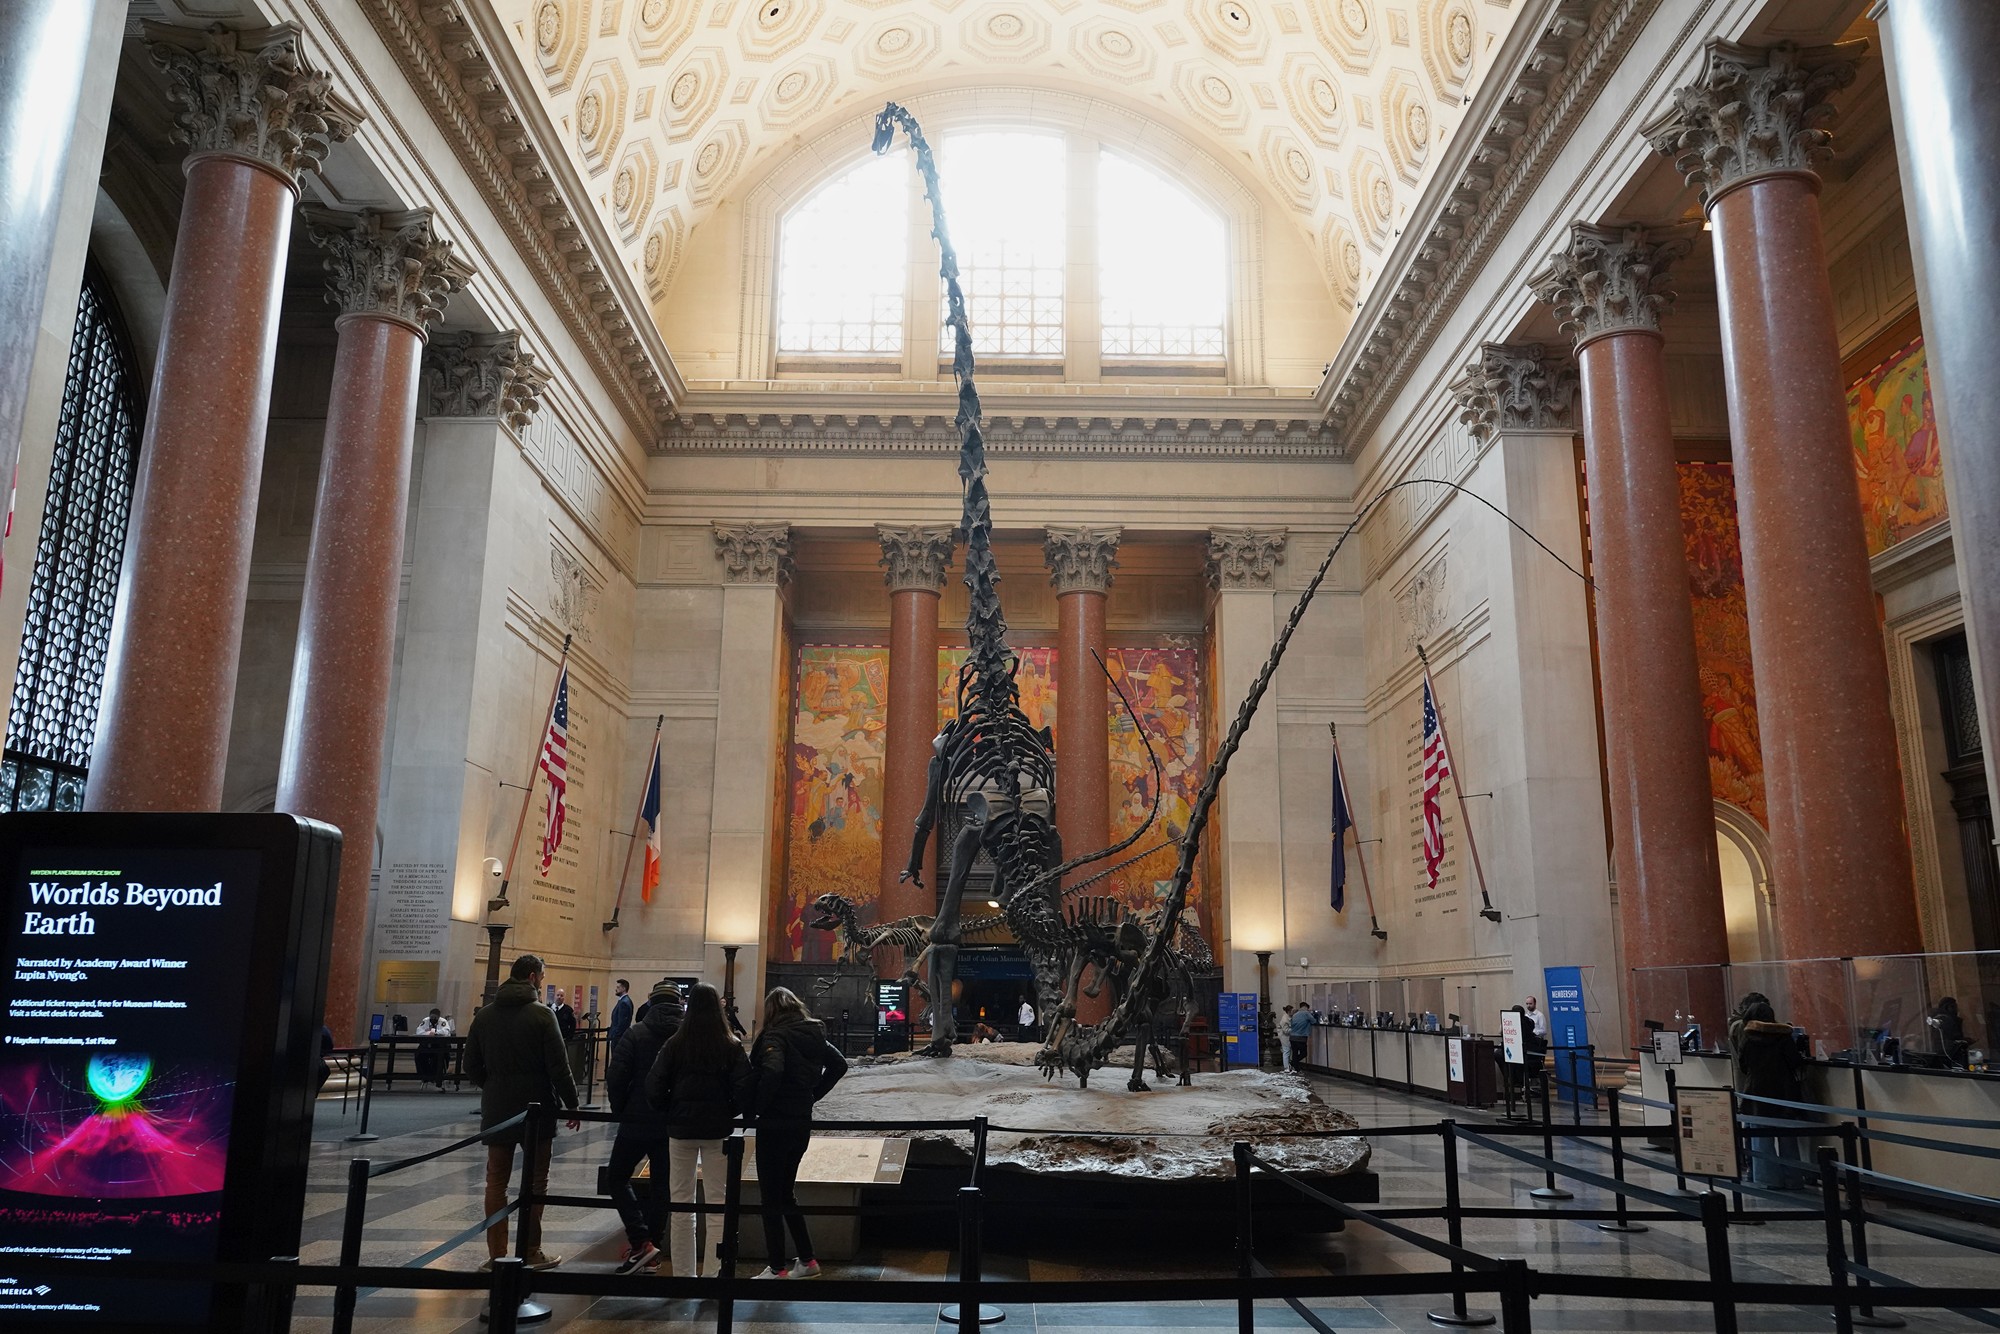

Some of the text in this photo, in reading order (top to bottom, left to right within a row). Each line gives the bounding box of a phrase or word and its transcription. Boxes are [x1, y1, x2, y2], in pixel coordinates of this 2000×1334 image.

[28, 881, 223, 911] Worlds Beyond
[22, 911, 95, 935] Earth
[16, 958, 188, 970] Narrated by Academy Award Winner
[14, 971, 46, 982] Lupita
[1551, 990, 1578, 998] MEMBERSHIP
[10, 999, 45, 1007] Additional
[66, 1000, 97, 1008] required,
[112, 1000, 123, 1008] for
[123, 1000, 152, 1008] Museum
[79, 1010, 104, 1018] details.
[1504, 1028, 1517, 1036] tickets
[12, 1037, 40, 1046] Hayden
[40, 1037, 84, 1046] Planetarium,
[85, 1037, 97, 1045] 1st
